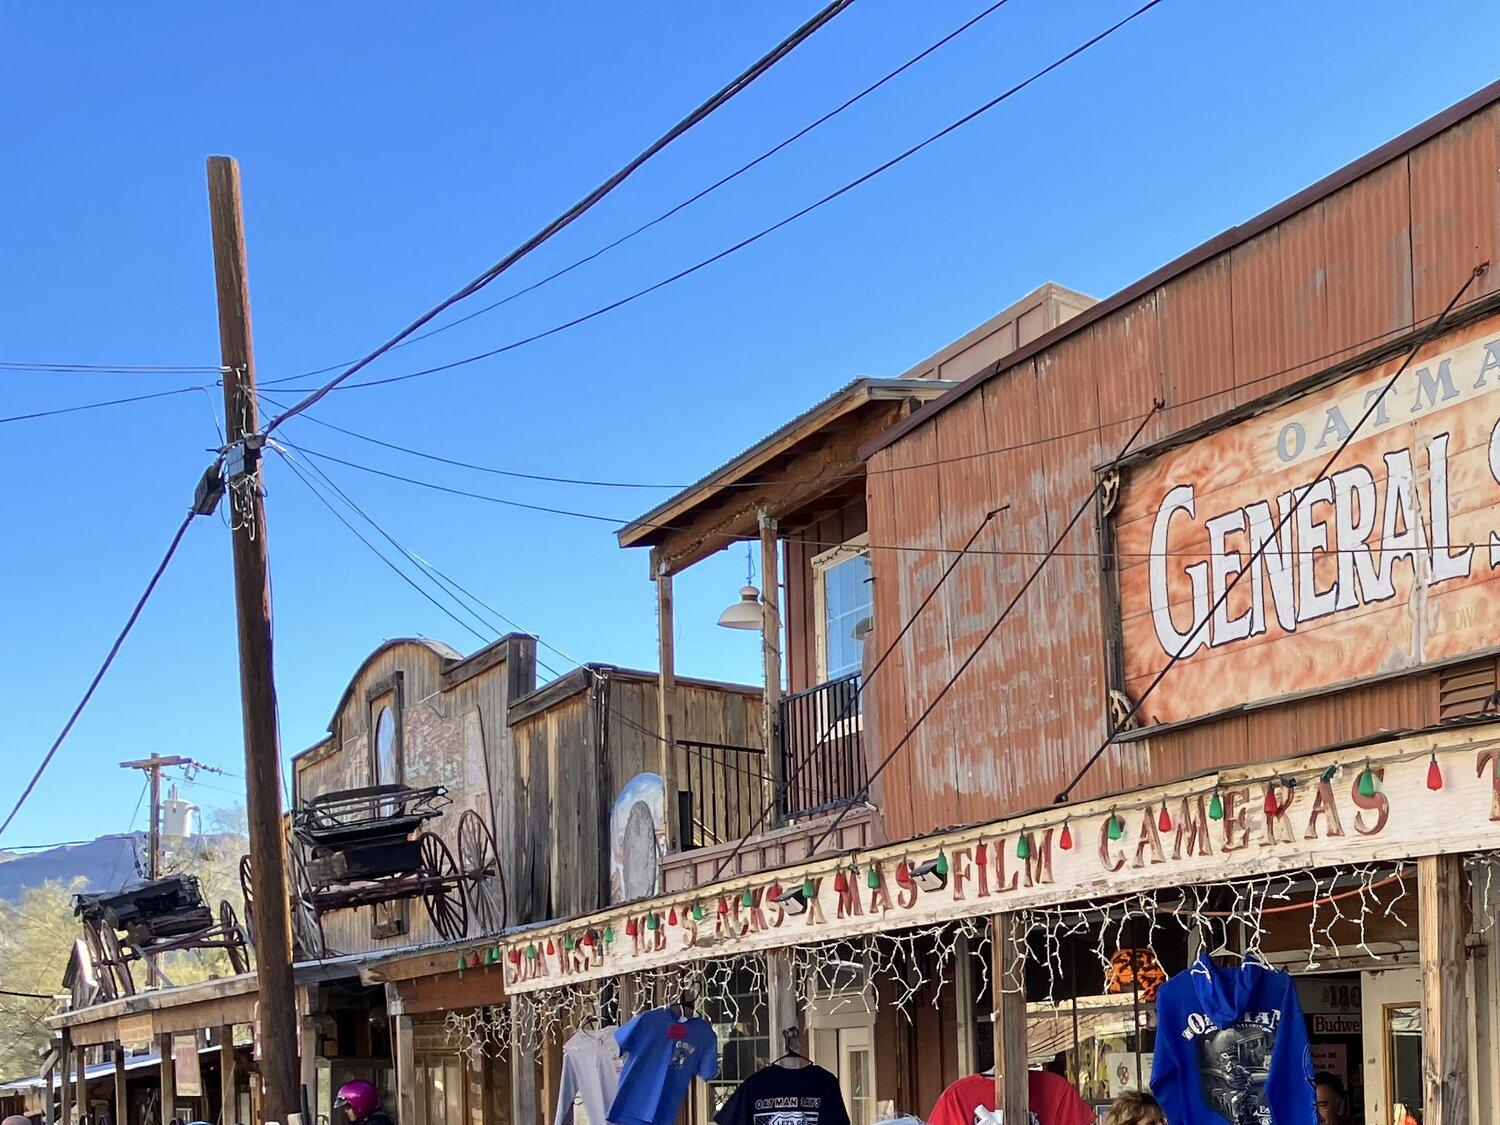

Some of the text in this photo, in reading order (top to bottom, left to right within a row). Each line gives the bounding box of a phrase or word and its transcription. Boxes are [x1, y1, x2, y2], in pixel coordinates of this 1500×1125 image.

[1148, 431, 1476, 660] GENERAL
[952, 828, 1054, 900] FILM
[1098, 766, 1391, 873] CAMERAS
[1315, 1015, 1360, 1032] Budwe
[755, 1097, 798, 1109] OATMAN
